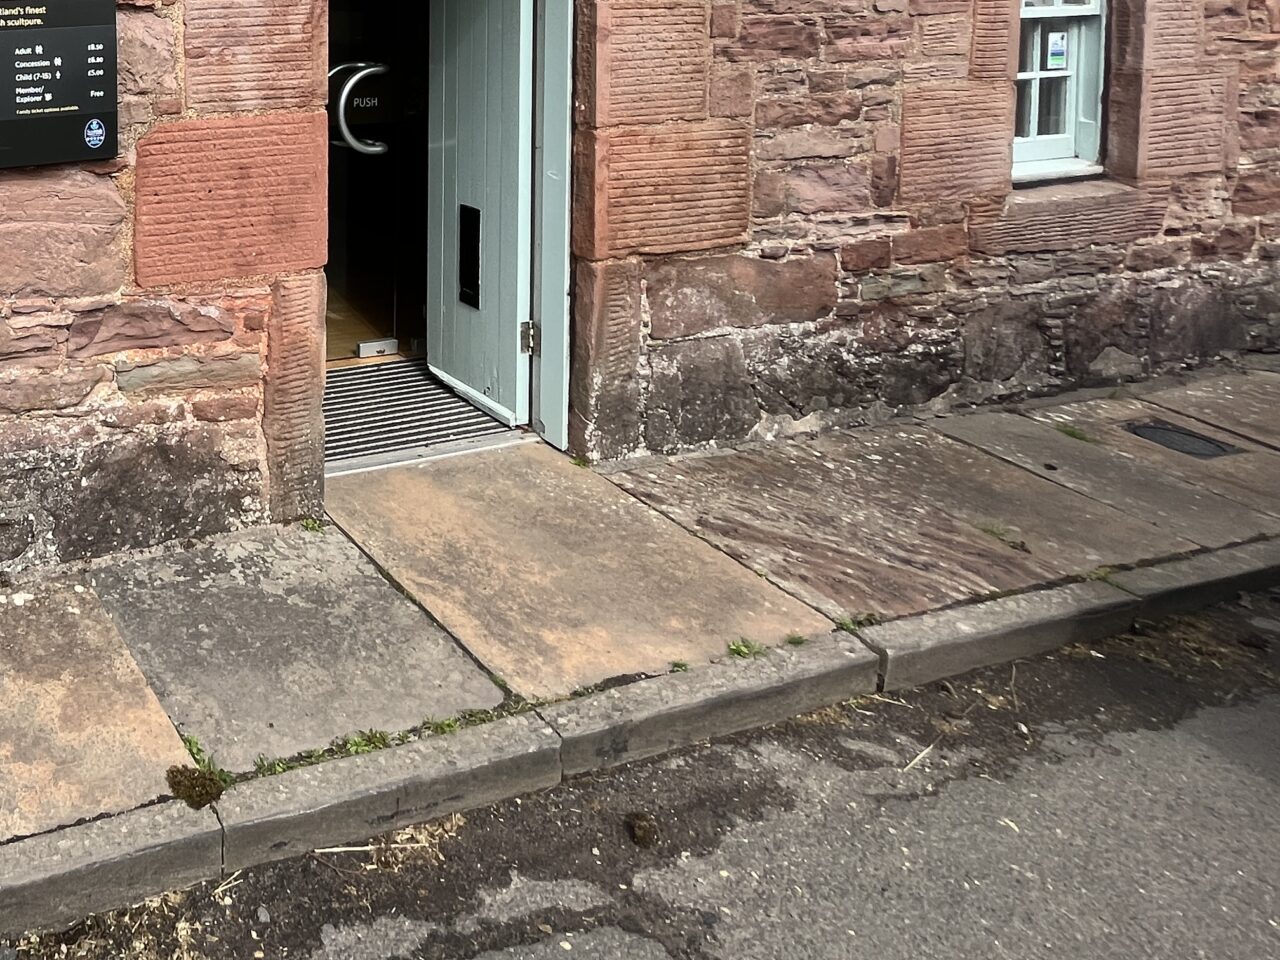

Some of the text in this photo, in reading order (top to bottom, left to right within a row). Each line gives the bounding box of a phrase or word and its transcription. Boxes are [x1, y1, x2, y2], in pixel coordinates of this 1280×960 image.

[25, 6, 46, 15] finest
[15, 60, 50, 68] Concession
[16, 73, 32, 81] Child
[353, 97, 378, 108] PUSH
